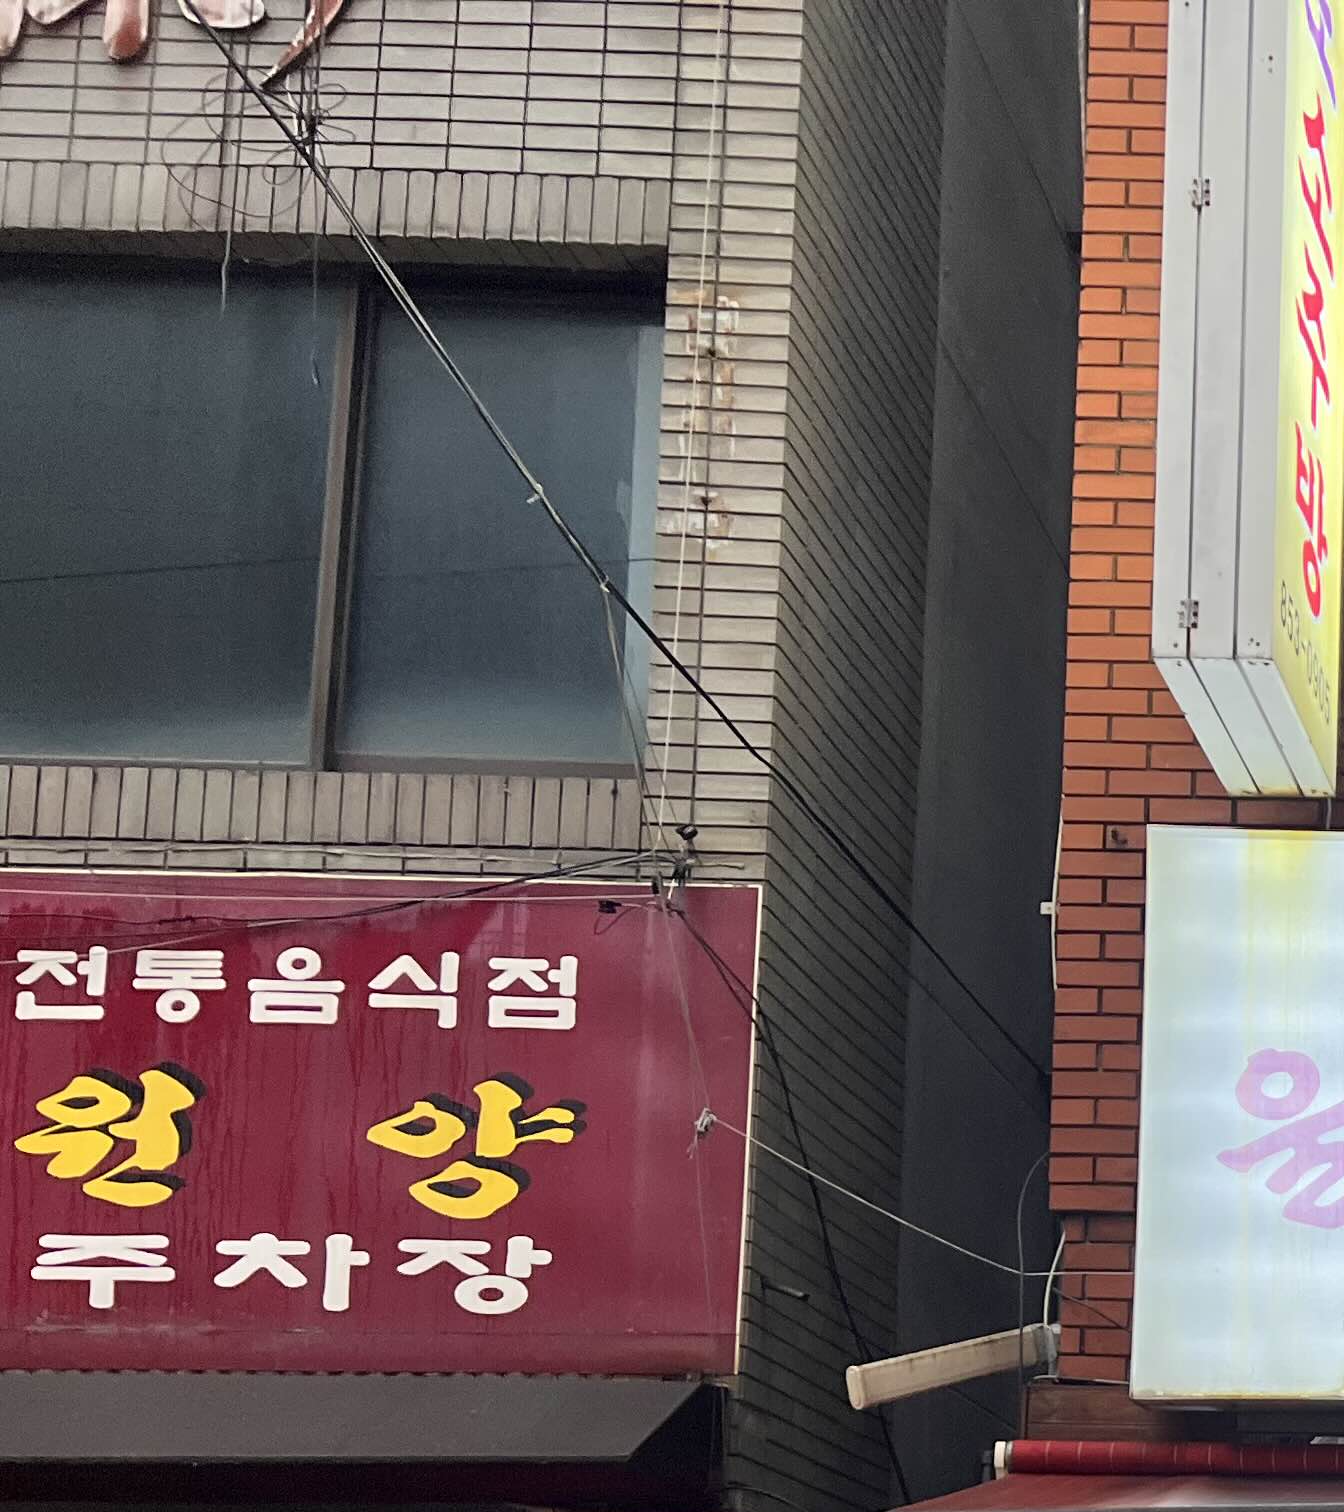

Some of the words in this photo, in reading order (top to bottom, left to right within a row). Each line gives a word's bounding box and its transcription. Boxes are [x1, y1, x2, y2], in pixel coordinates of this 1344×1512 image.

[1280, 580, 1330, 724] 853-0905
[14, 946, 579, 1031] 전통음식점
[31, 1232, 553, 1315] 주차장
